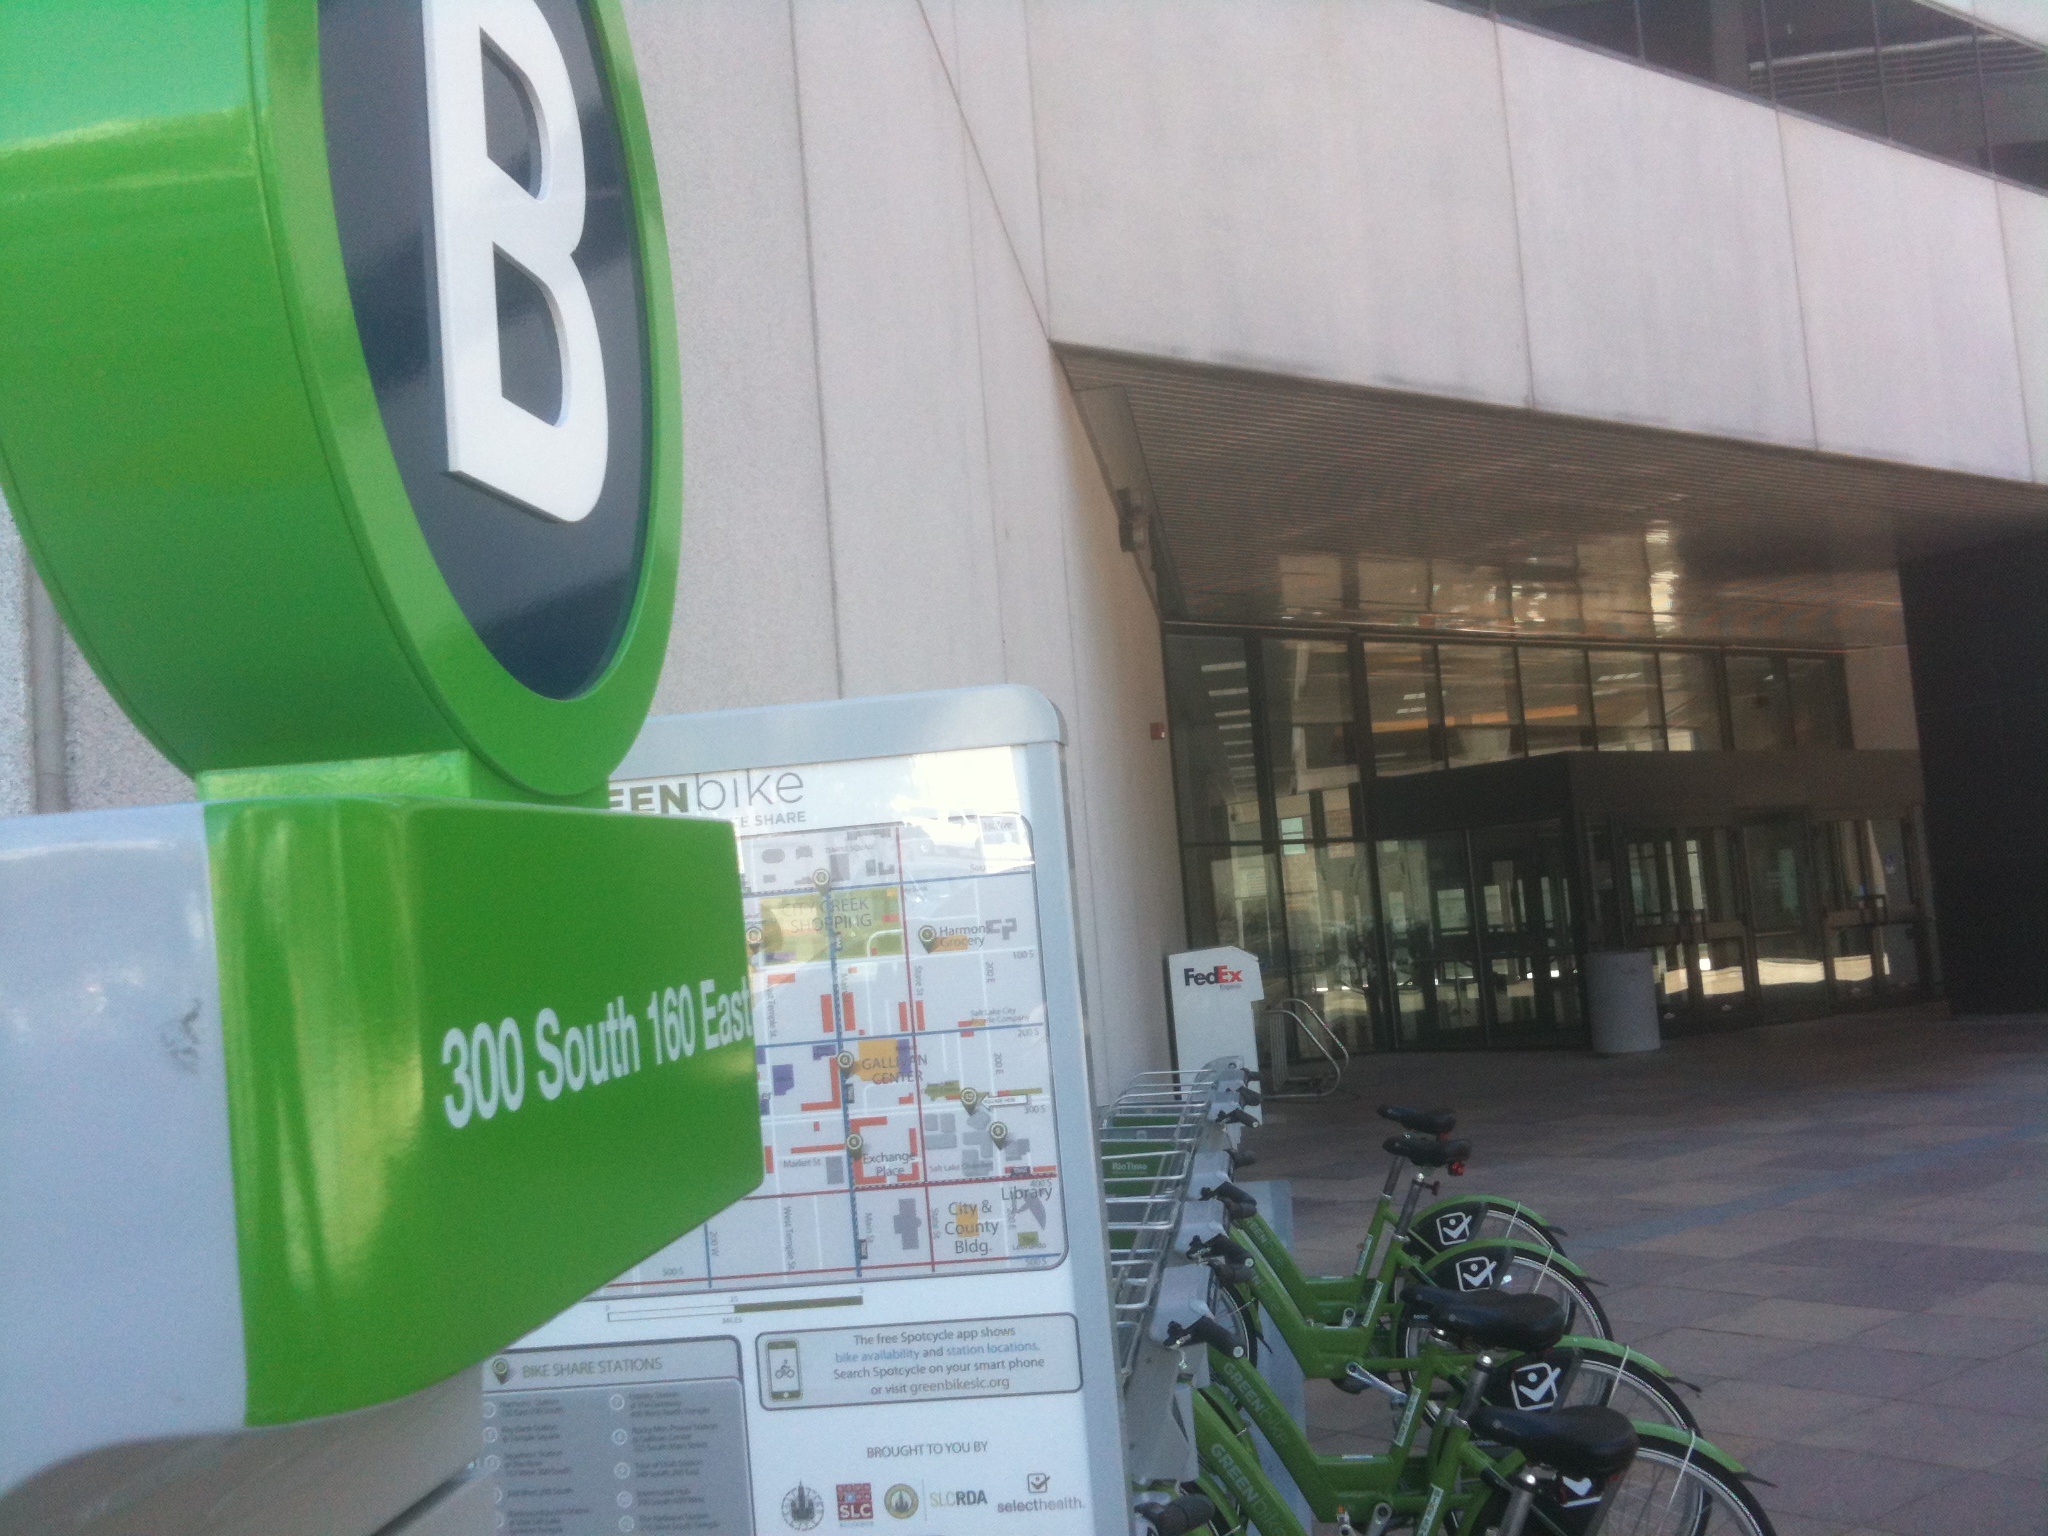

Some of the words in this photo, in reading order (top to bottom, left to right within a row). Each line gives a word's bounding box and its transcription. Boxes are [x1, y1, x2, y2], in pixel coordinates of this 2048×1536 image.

[422, 0, 608, 522] B
[755, 811, 806, 826] SHARE
[821, 897, 870, 913] CREEK
[790, 913, 872, 933] SHOPPING
[940, 936, 985, 948] Grocery
[1184, 965, 1243, 986] FedEx
[442, 1016, 525, 1128] 300
[534, 995, 641, 1101] South
[647, 983, 696, 1065] 160
[700, 975, 753, 1050] East
[872, 1070, 924, 1085] CENTER
[863, 1152, 916, 1164] Exchange
[876, 1166, 905, 1177] Place
[1001, 1186, 1053, 1201] Library
[948, 1201, 977, 1216] City
[981, 1200, 992, 1214] &
[945, 1220, 999, 1236] County
[955, 1240, 992, 1256] Bldg.
[854, 1334, 874, 1346] The
[876, 1332, 899, 1344] free
[901, 1330, 954, 1345] Spotcycle
[956, 1331, 978, 1342] app
[980, 1326, 1016, 1338] shows
[836, 1352, 858, 1363] bike
[861, 1348, 920, 1362] availability
[923, 1346, 944, 1358] and
[946, 1344, 984, 1357] station
[523, 1364, 550, 1378] BIKE
[553, 1362, 595, 1377] SHARE
[598, 1357, 662, 1374] STATIONS
[833, 1367, 870, 1379] Search
[873, 1364, 927, 1379] Spotcycle
[929, 1364, 943, 1374] on
[946, 1362, 971, 1375] your
[974, 1359, 1006, 1371] smart
[1008, 1357, 1045, 1371] phone
[870, 1387, 883, 1395] or
[885, 1382, 908, 1394] visit
[910, 1377, 1010, 1393] greenbikeslc.org
[866, 1444, 926, 1459] BROUGHT
[928, 1444, 944, 1455] TO
[944, 1442, 971, 1455] YOU
[973, 1440, 988, 1452] BY
[839, 1503, 872, 1518] SLC
